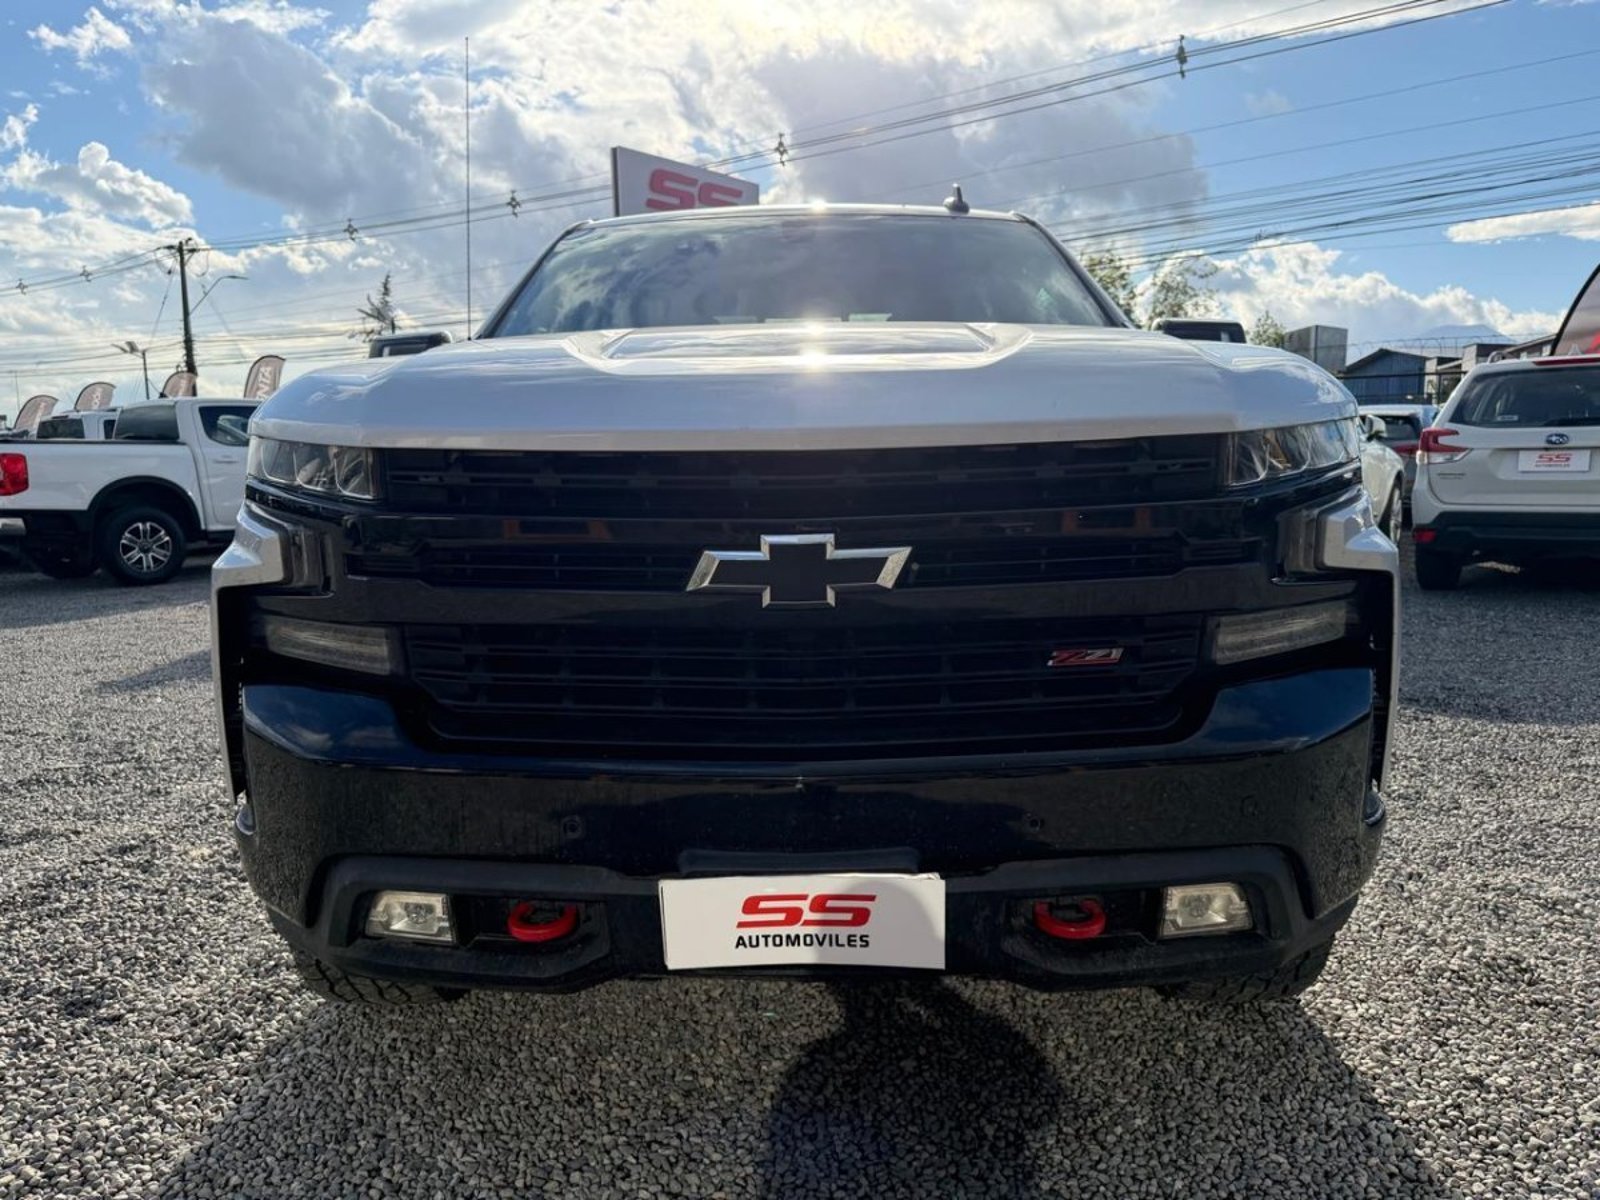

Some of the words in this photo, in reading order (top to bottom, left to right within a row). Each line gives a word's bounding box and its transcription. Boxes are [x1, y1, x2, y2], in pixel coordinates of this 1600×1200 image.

[646, 168, 743, 210] SS
[1536, 453, 1573, 464] SS
[1047, 647, 1124, 666] Z71
[736, 893, 877, 929] SS
[735, 933, 870, 949] AUTOMOVILES
